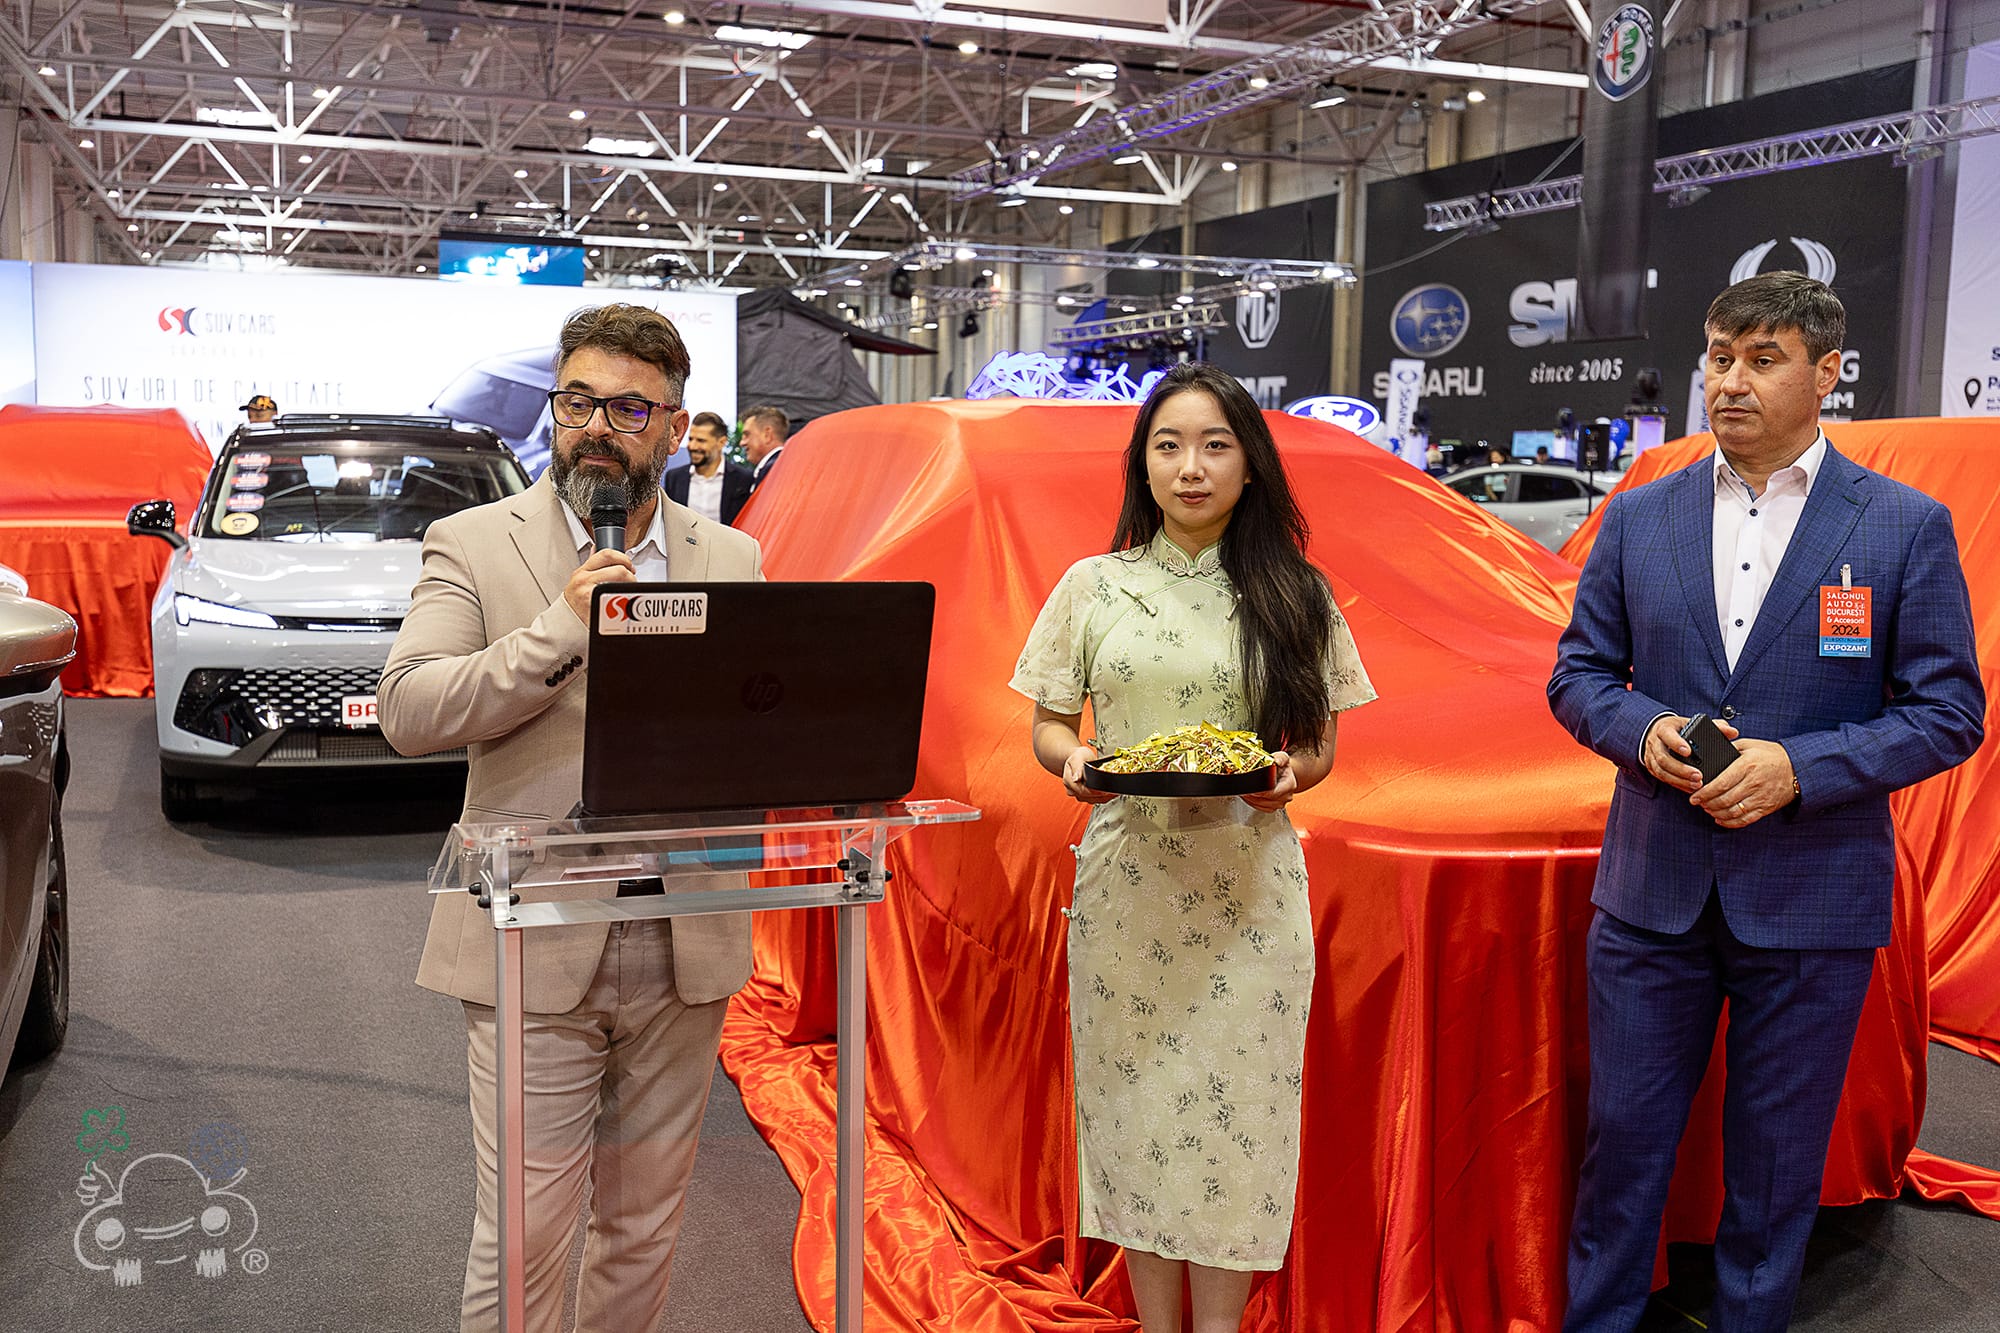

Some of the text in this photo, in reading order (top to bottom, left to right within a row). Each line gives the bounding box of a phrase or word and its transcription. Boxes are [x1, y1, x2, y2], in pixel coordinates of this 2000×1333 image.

[1529, 358, 1623, 384] since 2005
[194, 379, 215, 402] DE
[1373, 367, 1484, 398] SARU
[1821, 391, 1855, 410] GM
[1826, 592, 1865, 600] SALONUL
[1832, 625, 1860, 636] 2024
[1823, 644, 1868, 652] EXPOZANT
